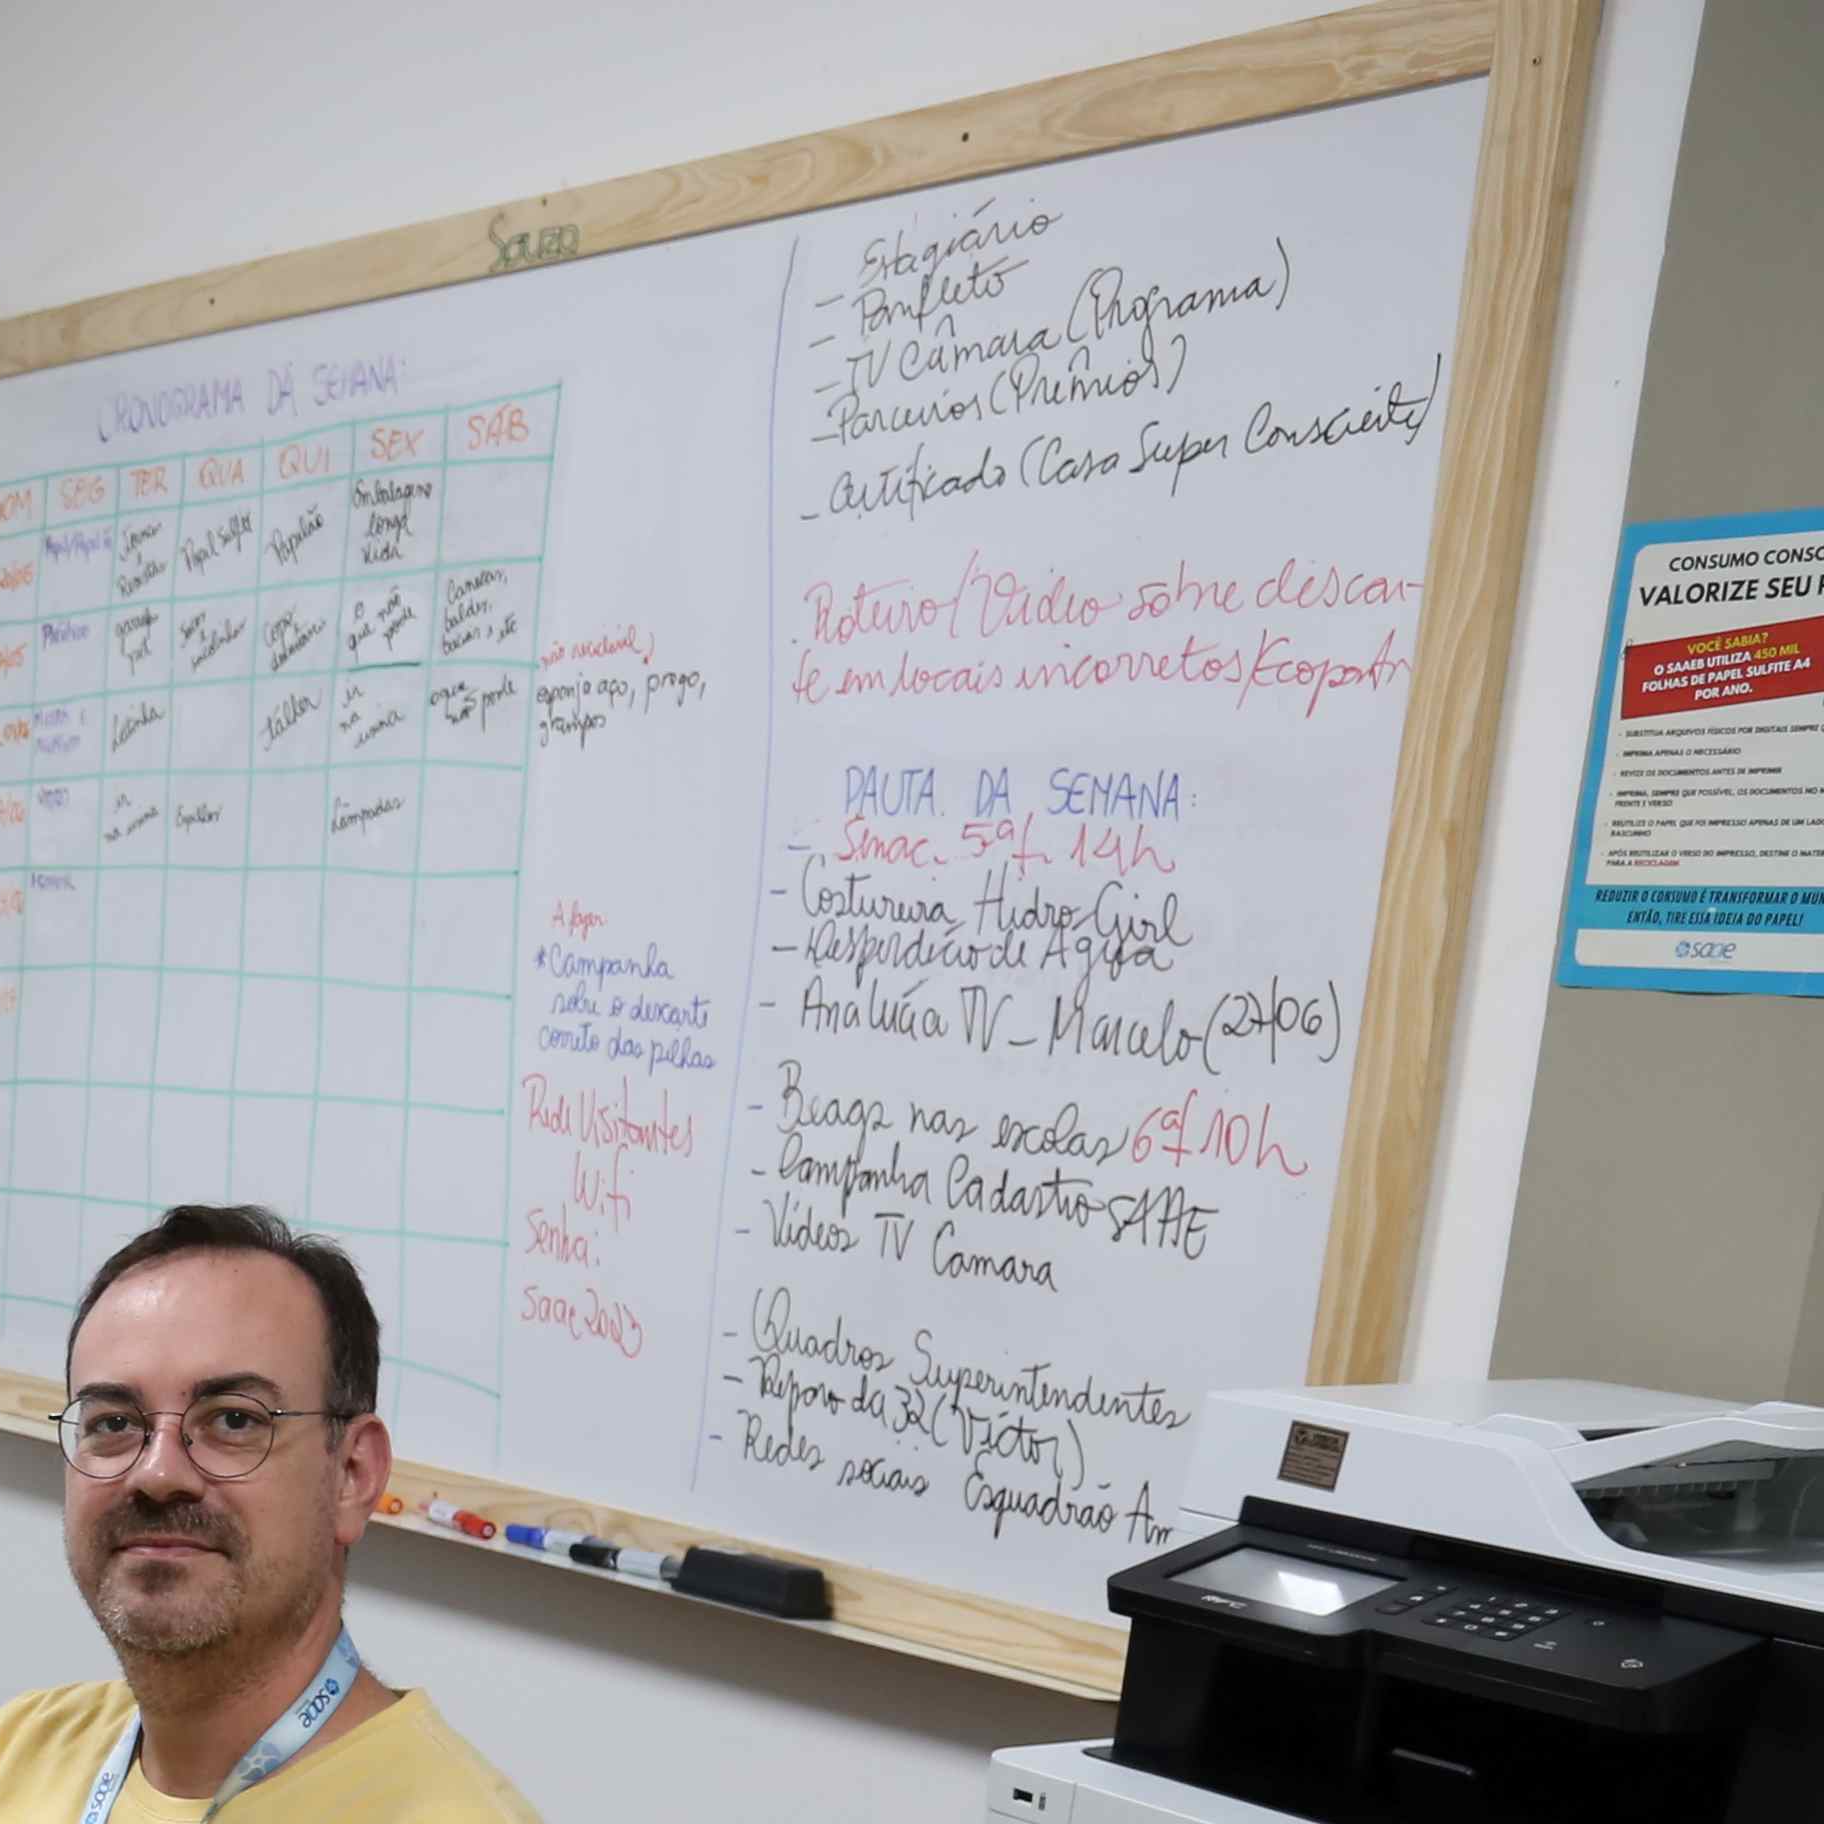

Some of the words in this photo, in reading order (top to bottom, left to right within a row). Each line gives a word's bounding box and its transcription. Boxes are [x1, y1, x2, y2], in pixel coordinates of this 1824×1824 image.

[846, 340, 891, 398] TV
[58, 475, 106, 509] SEG
[128, 466, 168, 498] TER
[198, 457, 245, 490] QUA
[279, 444, 330, 480] QUI
[370, 427, 424, 462] SEX
[1129, 421, 1228, 497] Super
[1669, 551, 1759, 572] CONSUMO
[1640, 579, 1758, 607] VALORIZE
[1765, 576, 1811, 599] SEU
[1653, 664, 1664, 676] O
[1666, 658, 1705, 675] SAAEB
[1707, 651, 1752, 669] UTILIZA
[1754, 646, 1777, 660] 450
[1778, 643, 1801, 657] MIL
[1687, 638, 1721, 655] VOCÊ
[1725, 632, 1769, 649] SABIA?
[1642, 674, 1689, 693] FOLHAS
[1690, 671, 1705, 686] DE
[1708, 667, 1744, 684] PAPEL
[1746, 661, 1791, 678] SULFITE
[1792, 656, 1811, 672] A4
[1694, 686, 1720, 701] POR
[1721, 682, 1753, 698] ANO.
[976, 769, 1011, 815] DA
[1708, 890, 1788, 905] TRANSFORMAR
[1665, 911, 1688, 926] TIRE
[1713, 912, 1744, 927] IDEIA
[875, 1212, 913, 1260] TV
